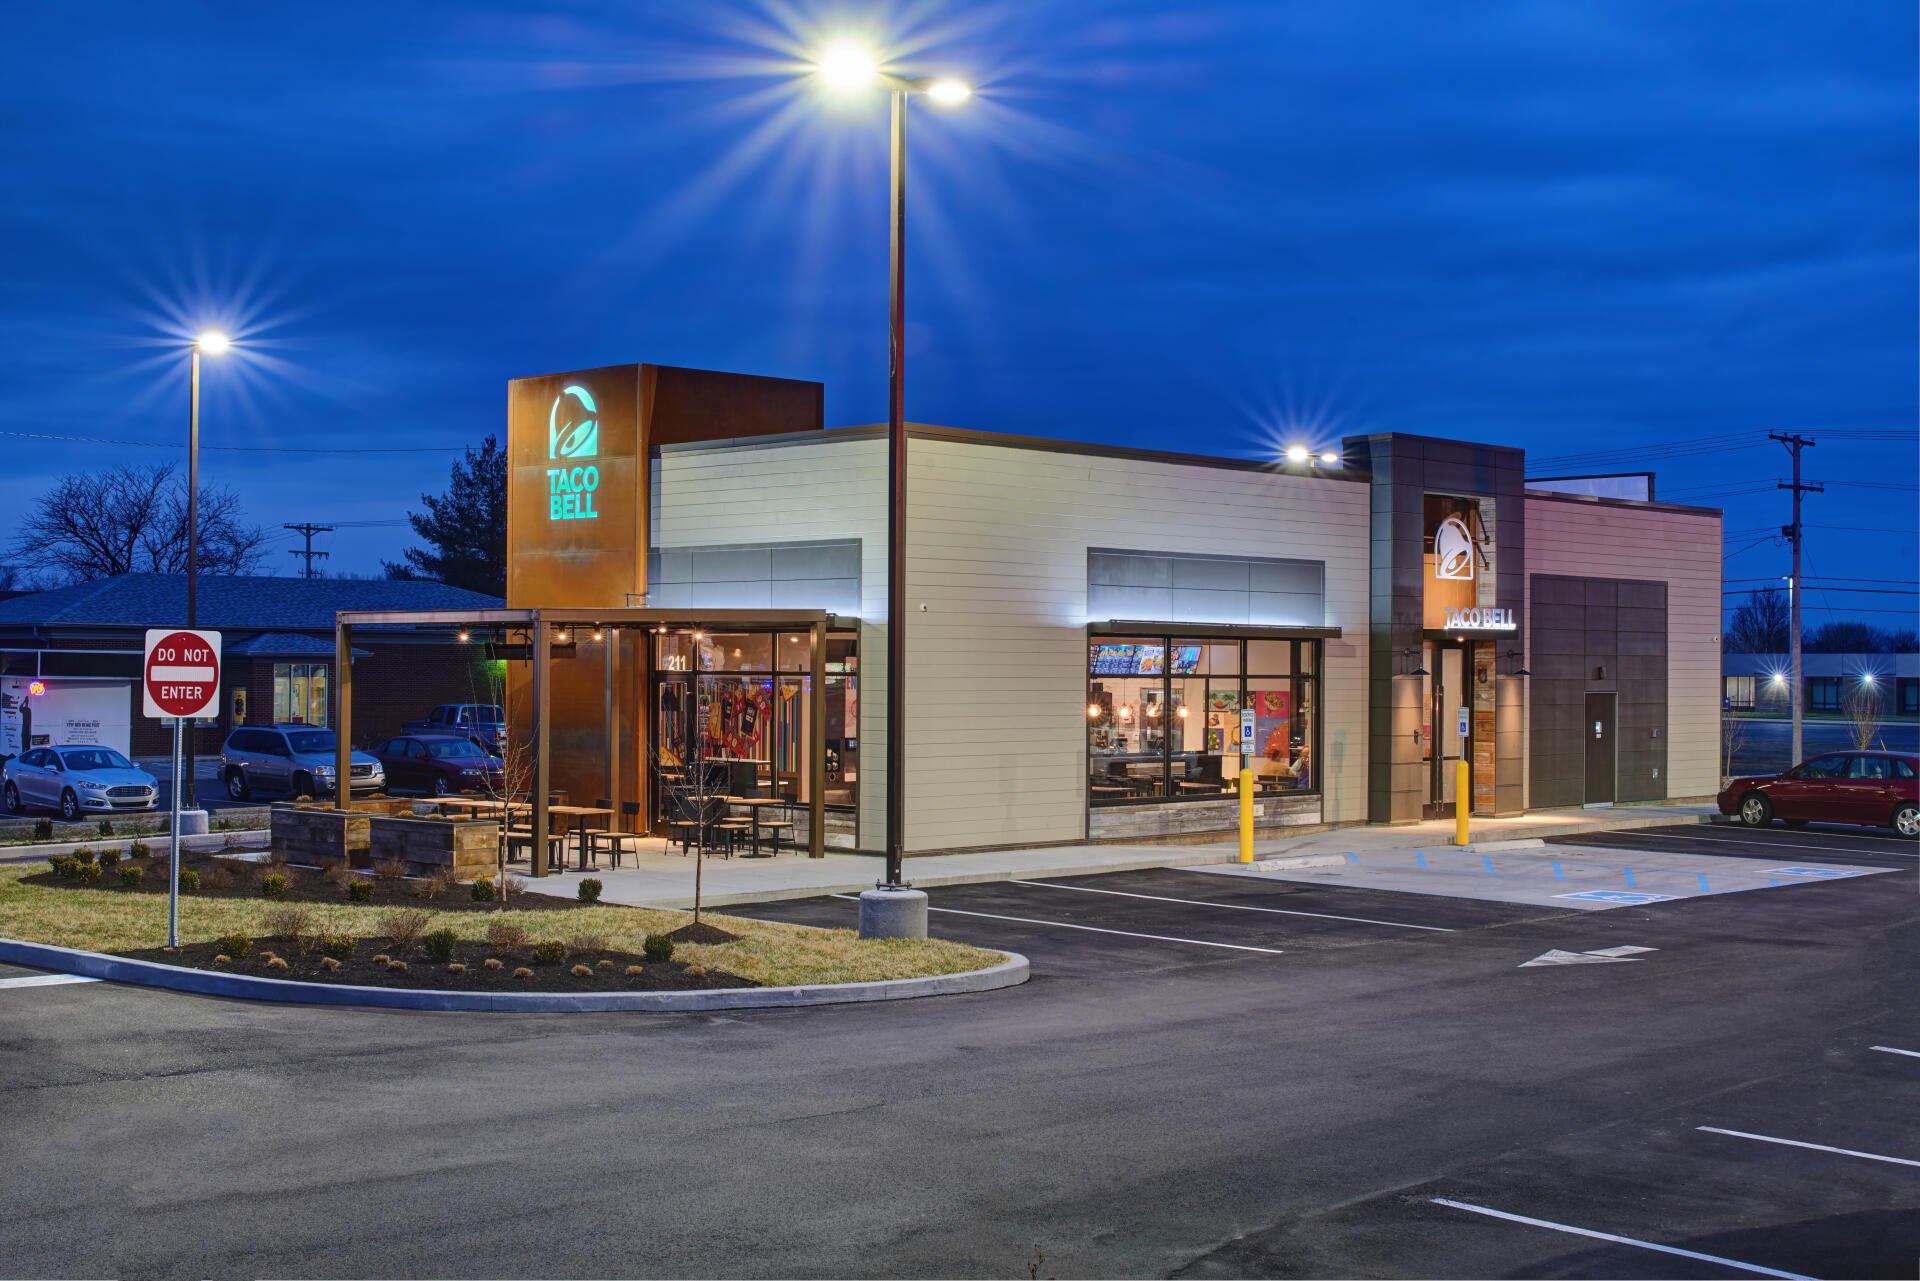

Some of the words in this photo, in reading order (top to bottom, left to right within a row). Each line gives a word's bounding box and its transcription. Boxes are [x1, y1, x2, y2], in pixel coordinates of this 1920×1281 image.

[547, 466, 599, 493] TACO
[550, 493, 598, 520] BELL
[1444, 607, 1481, 630] TACO
[1483, 608, 1517, 630] BELL
[158, 648, 176, 662] DO
[184, 648, 209, 663] NOT
[668, 655, 686, 670] 211
[161, 685, 202, 700] ENTER
